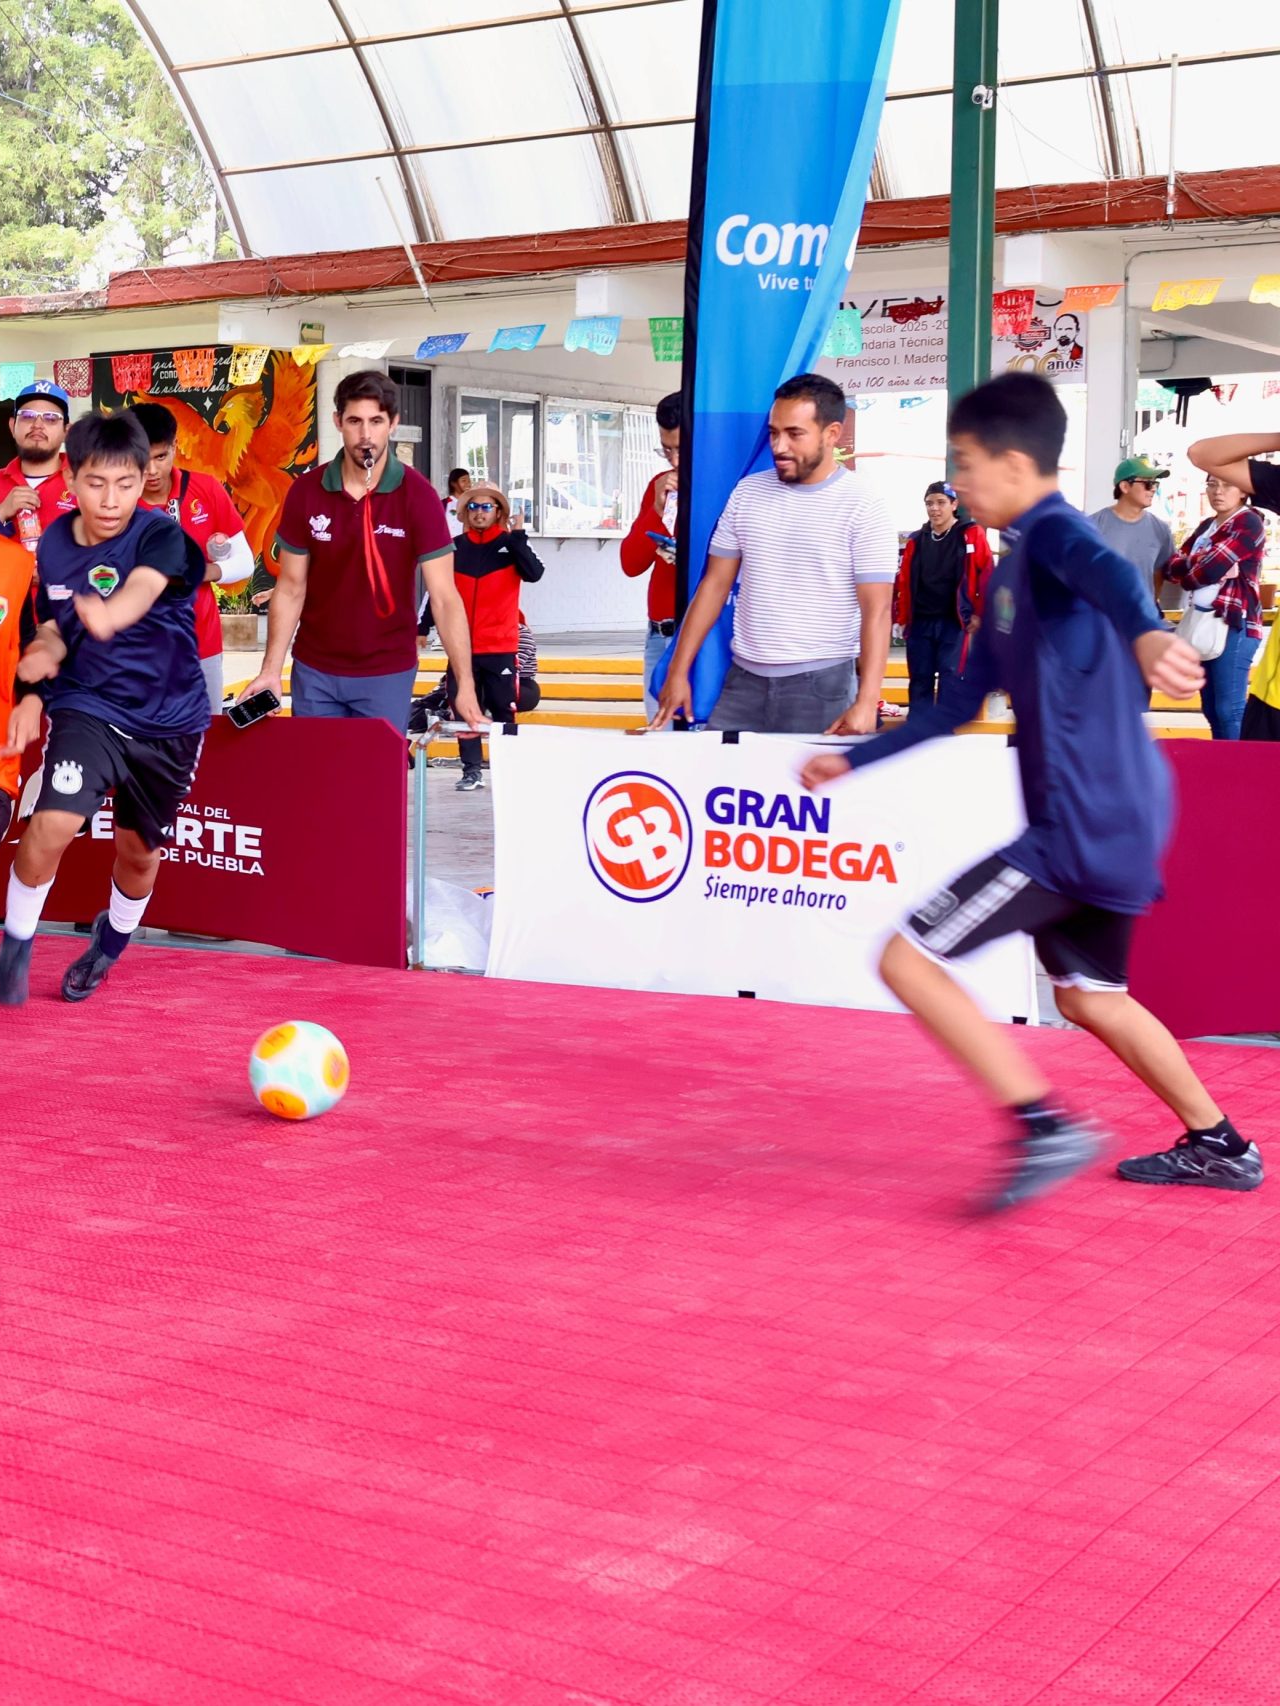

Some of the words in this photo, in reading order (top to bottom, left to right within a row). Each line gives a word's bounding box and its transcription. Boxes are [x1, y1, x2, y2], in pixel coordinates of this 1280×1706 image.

[716, 214, 830, 266] Com
[758, 273, 799, 290] Vive
[900, 320, 928, 333] 2025
[861, 338, 896, 350] ndaria
[900, 336, 944, 348] Técnica
[836, 357, 890, 368] Francisco
[904, 353, 948, 364] Madero
[848, 379, 861, 389] los
[866, 376, 884, 388] 100
[888, 376, 910, 387] años
[914, 375, 925, 386] de
[204, 806, 231, 820] DEL
[705, 786, 831, 834] GRAN
[160, 847, 180, 862] DE
[185, 850, 265, 876] PUEBLA
[704, 829, 899, 884] BODEGA
[782, 883, 848, 911] ahorro
